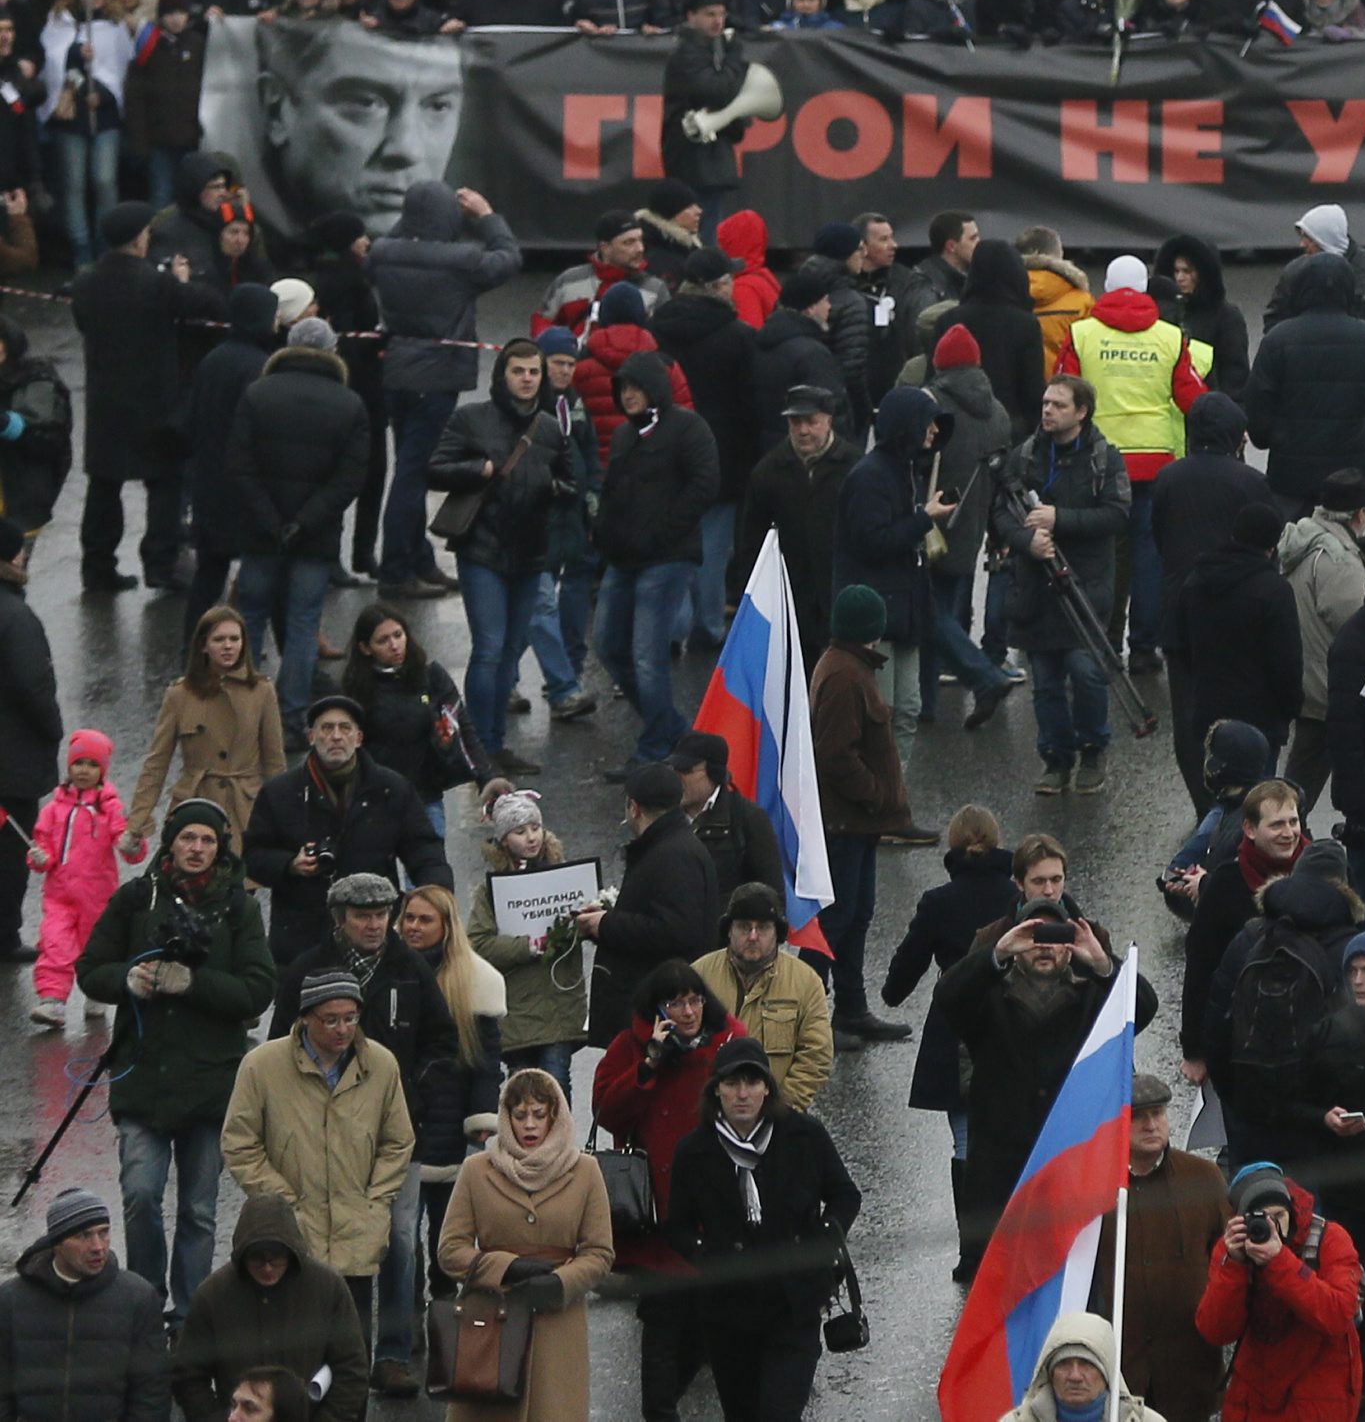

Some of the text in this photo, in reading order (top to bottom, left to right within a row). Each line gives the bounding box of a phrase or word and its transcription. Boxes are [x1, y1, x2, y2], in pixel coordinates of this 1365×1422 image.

[1060, 99, 1224, 184] НЕ
[1100, 348, 1159, 363] ПРЕССА
[507, 889, 585, 910] ПРОПАГАНДА
[521, 904, 574, 921] УБИВАЕТ
